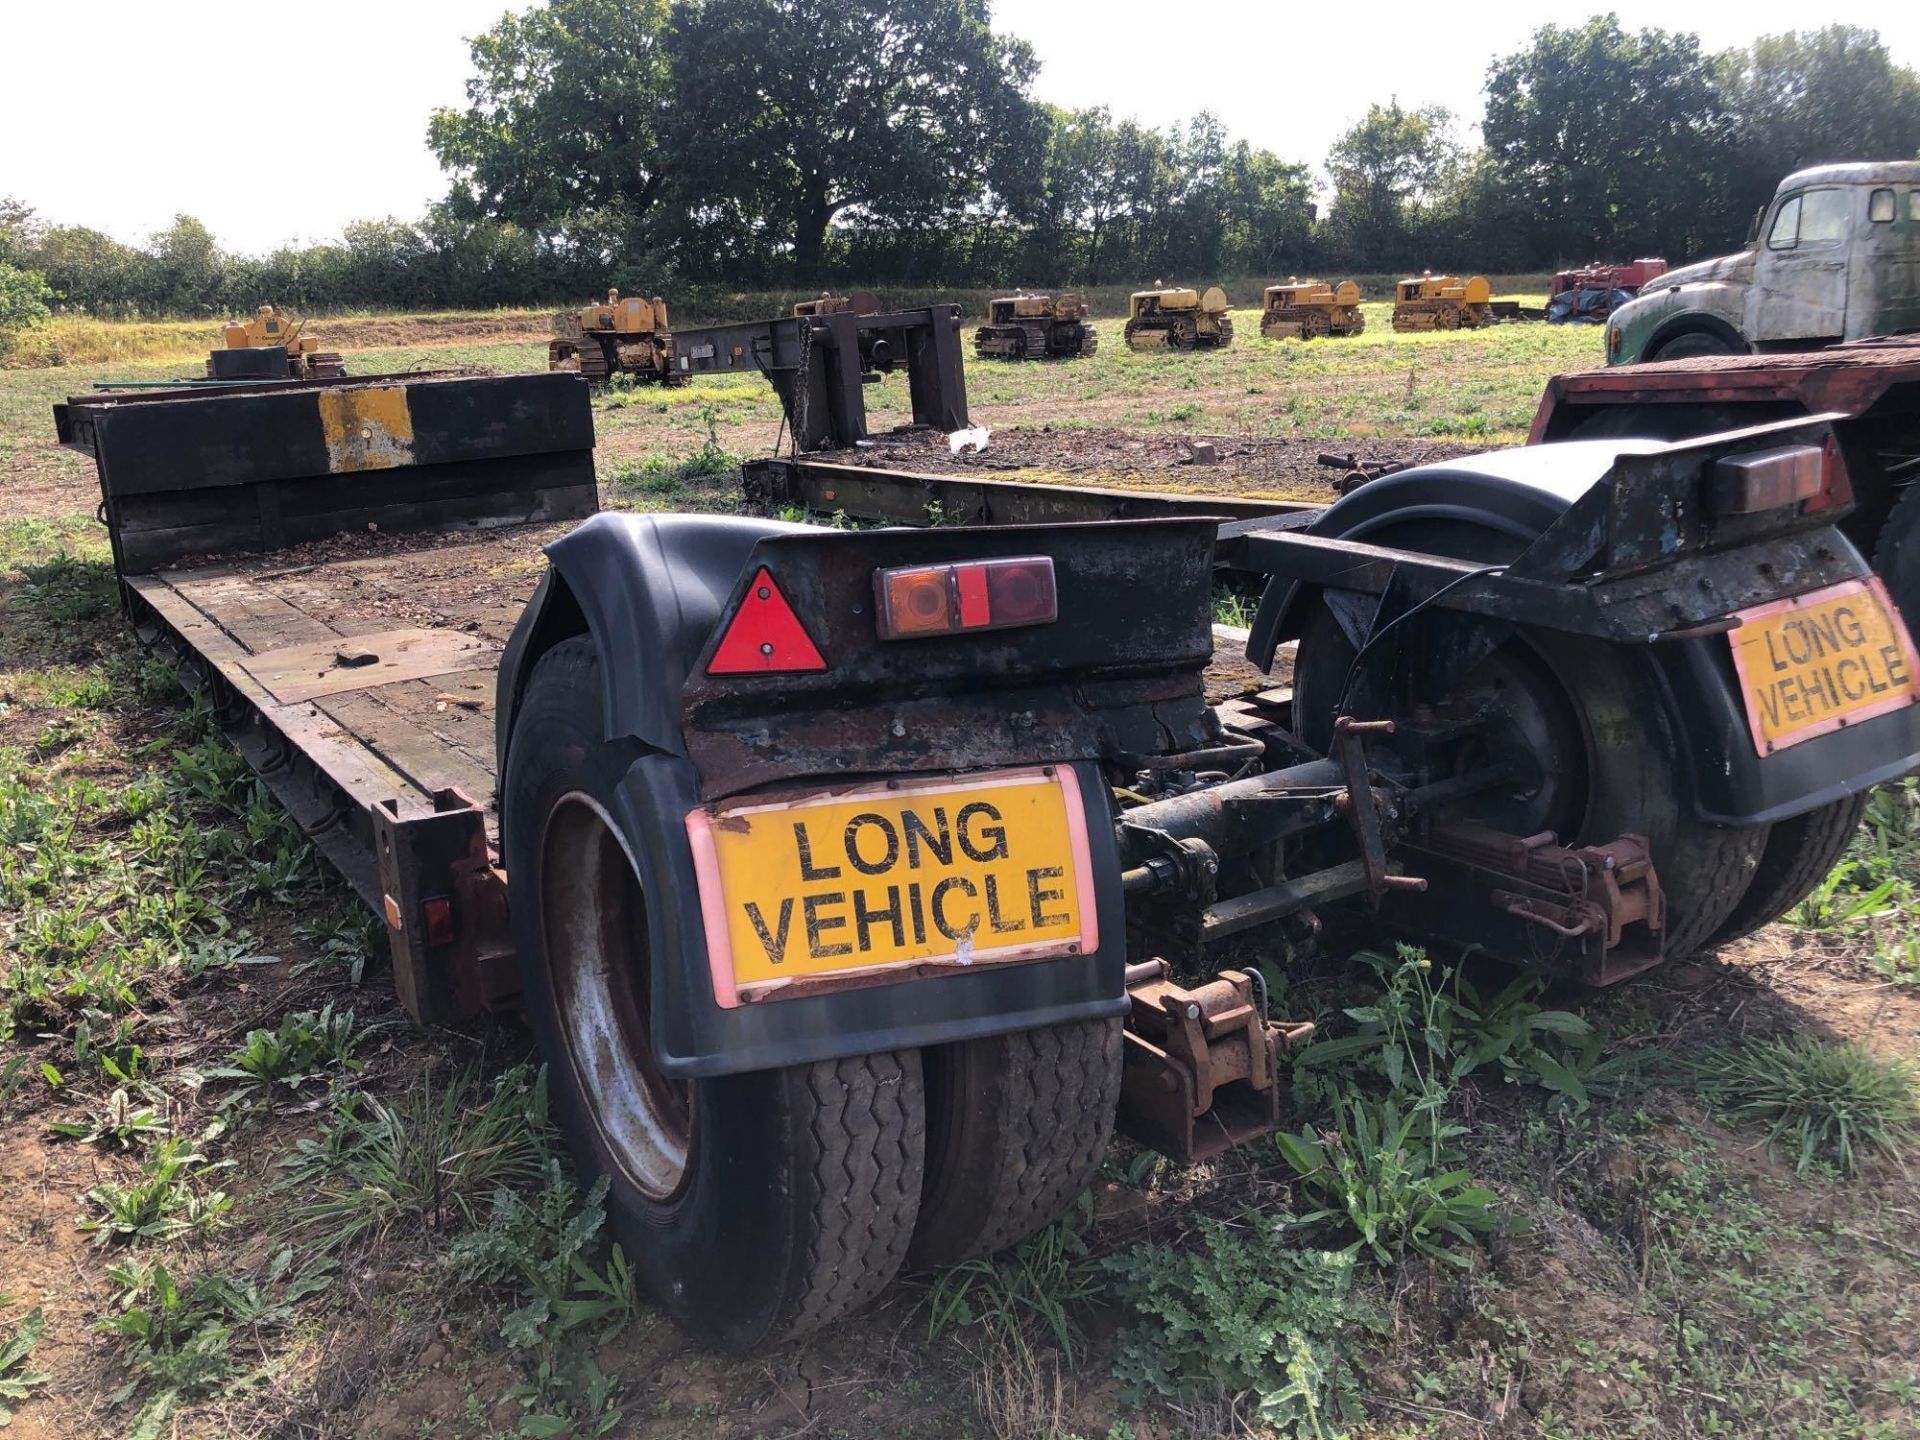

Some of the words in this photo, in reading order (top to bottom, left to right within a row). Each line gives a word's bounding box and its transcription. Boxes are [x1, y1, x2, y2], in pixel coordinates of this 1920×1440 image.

[1765, 607, 1866, 672] LONG
[1757, 645, 1910, 728] VEHICLE
[793, 802, 1009, 882] LONG
[743, 866, 1071, 964] VEHICLE
